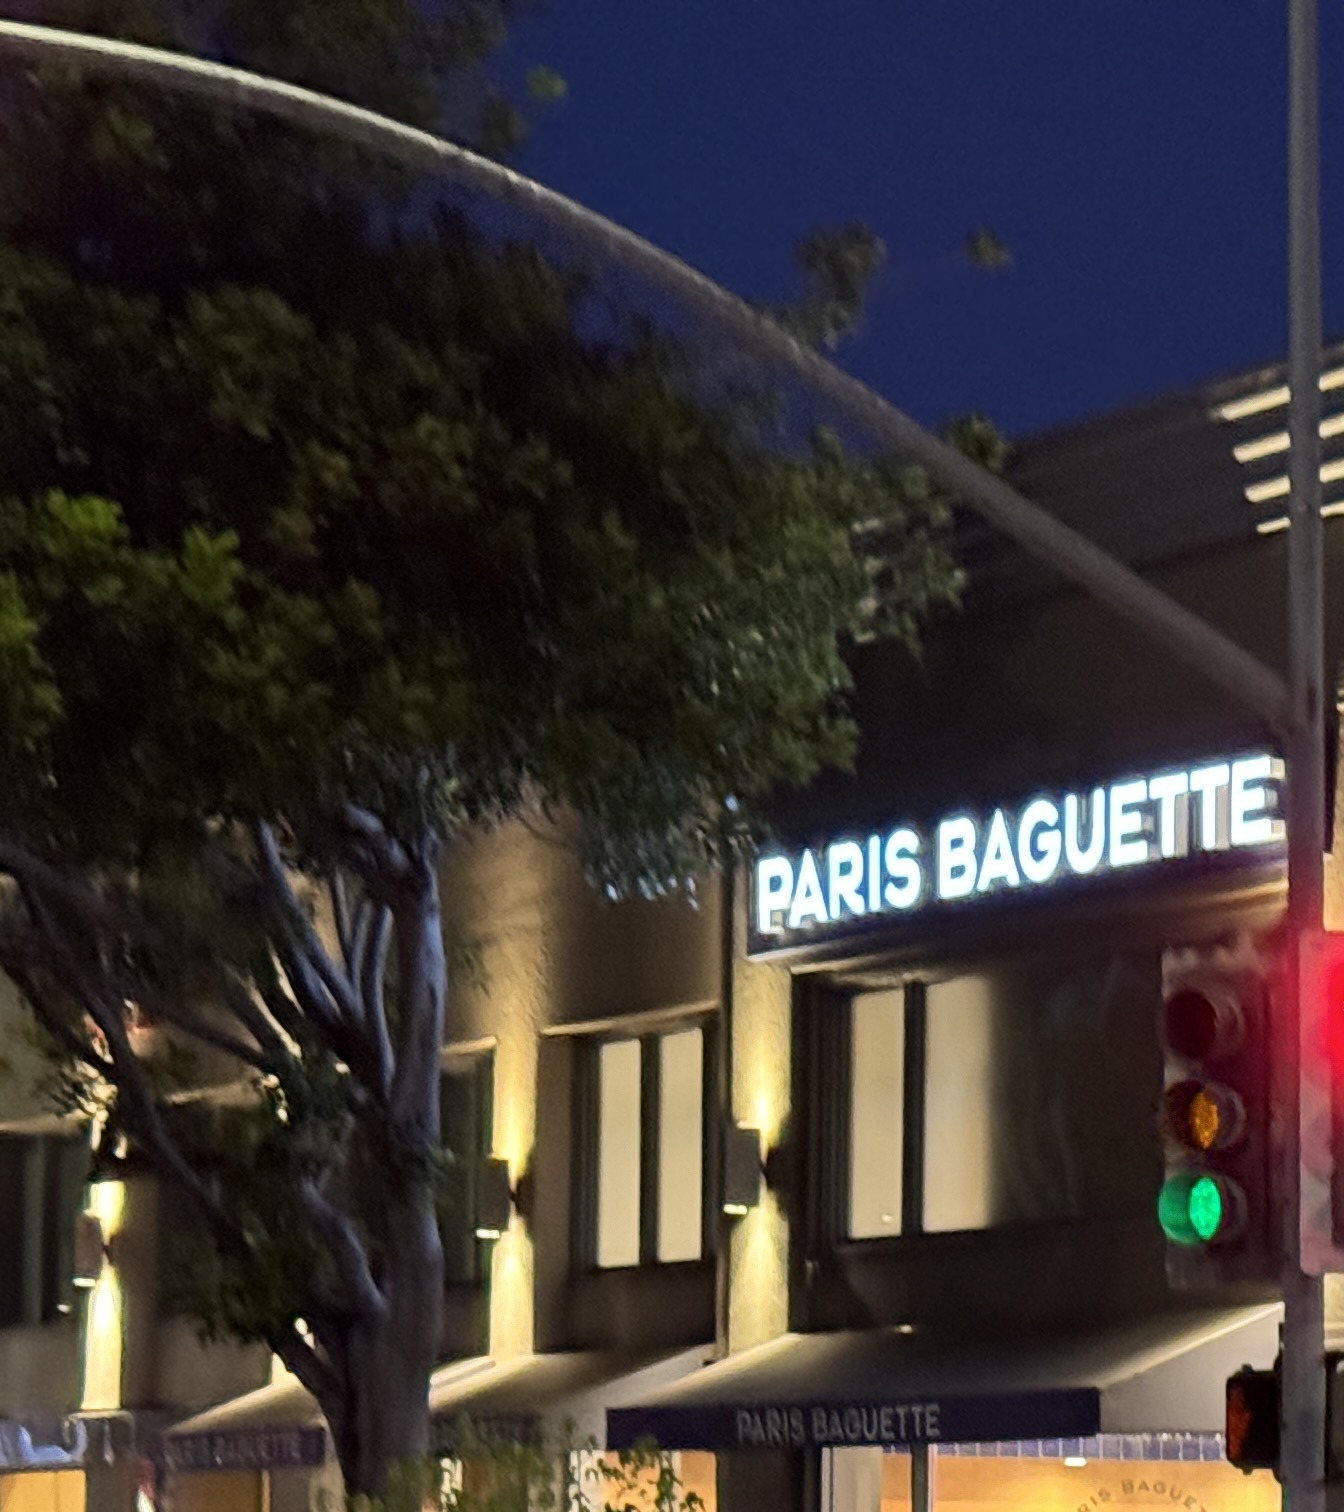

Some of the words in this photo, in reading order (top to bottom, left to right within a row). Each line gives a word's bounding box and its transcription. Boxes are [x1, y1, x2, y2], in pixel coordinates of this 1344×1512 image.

[757, 826, 921, 936] PARIS
[936, 753, 1286, 900] BAGUETTE
[736, 1407, 805, 1444] PARIS
[812, 1402, 941, 1442] BAGUETTE
